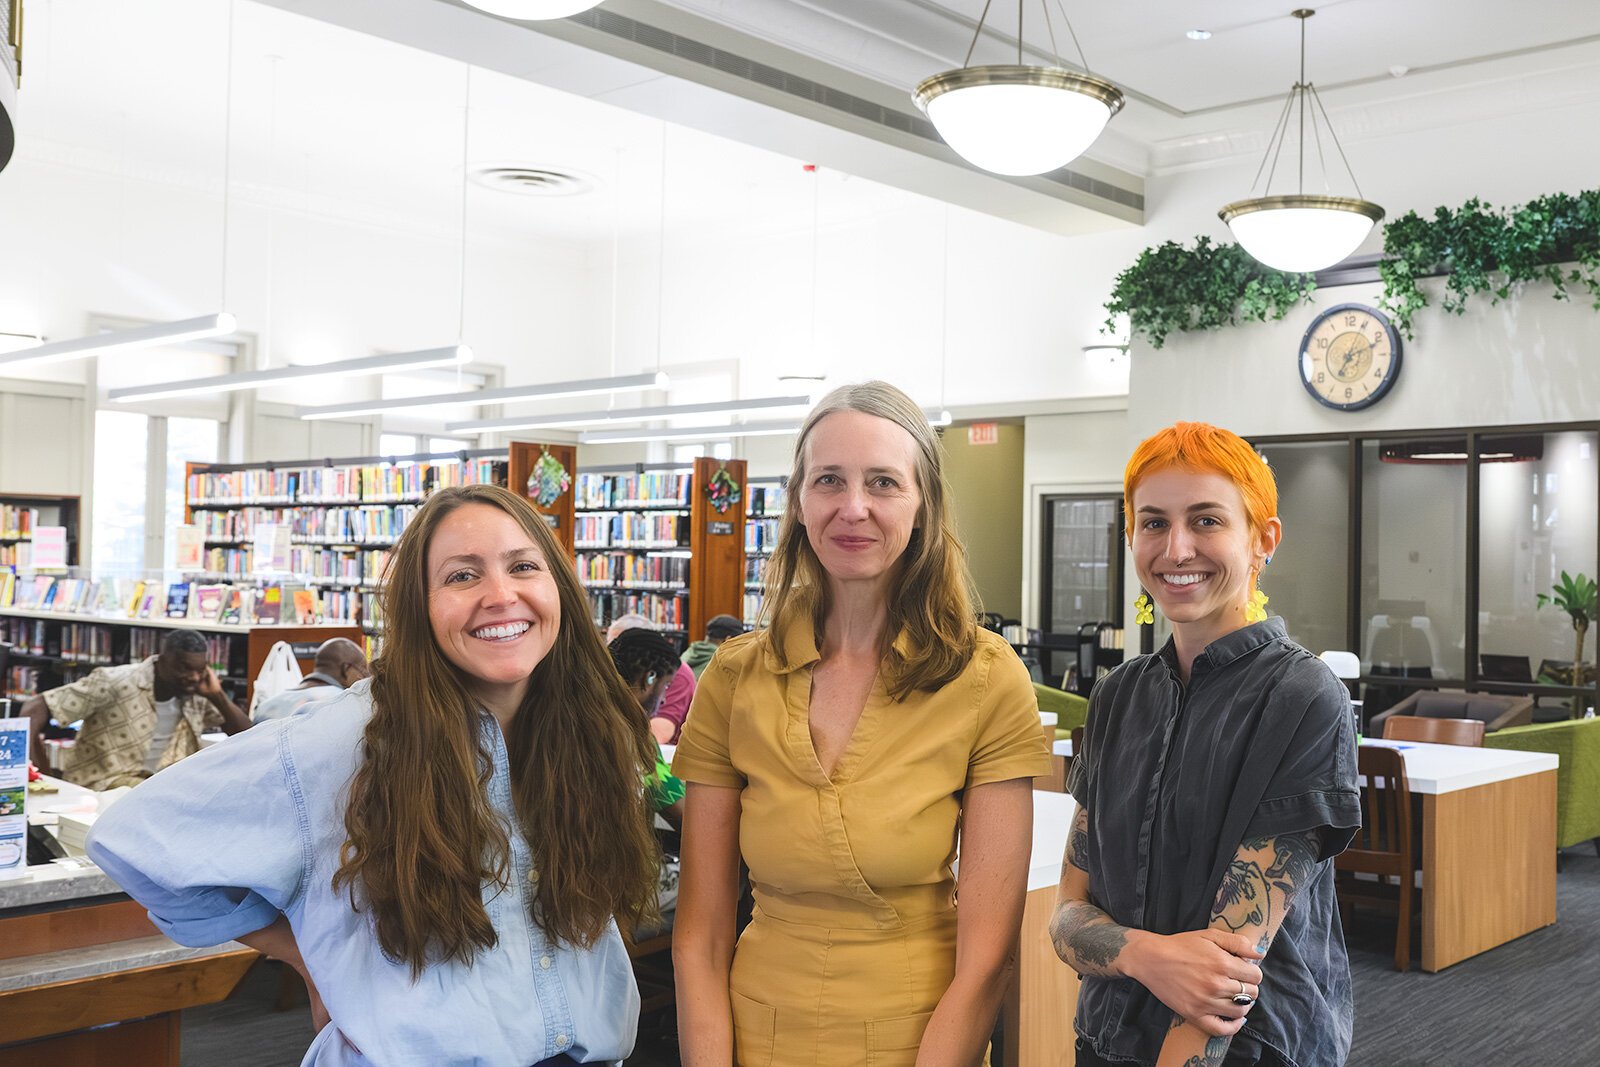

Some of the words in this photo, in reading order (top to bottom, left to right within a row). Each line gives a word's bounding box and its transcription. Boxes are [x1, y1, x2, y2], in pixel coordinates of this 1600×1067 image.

[1344, 315, 1356, 327] 12
[1375, 331, 1383, 343] 2
[1316, 338, 1329, 349] 10
[1318, 372, 1325, 383] 8
[1374, 368, 1382, 378] 4
[1345, 387, 1353, 399] 6
[972, 423, 993, 441] EXIT
[0, 736, 8, 746] 7
